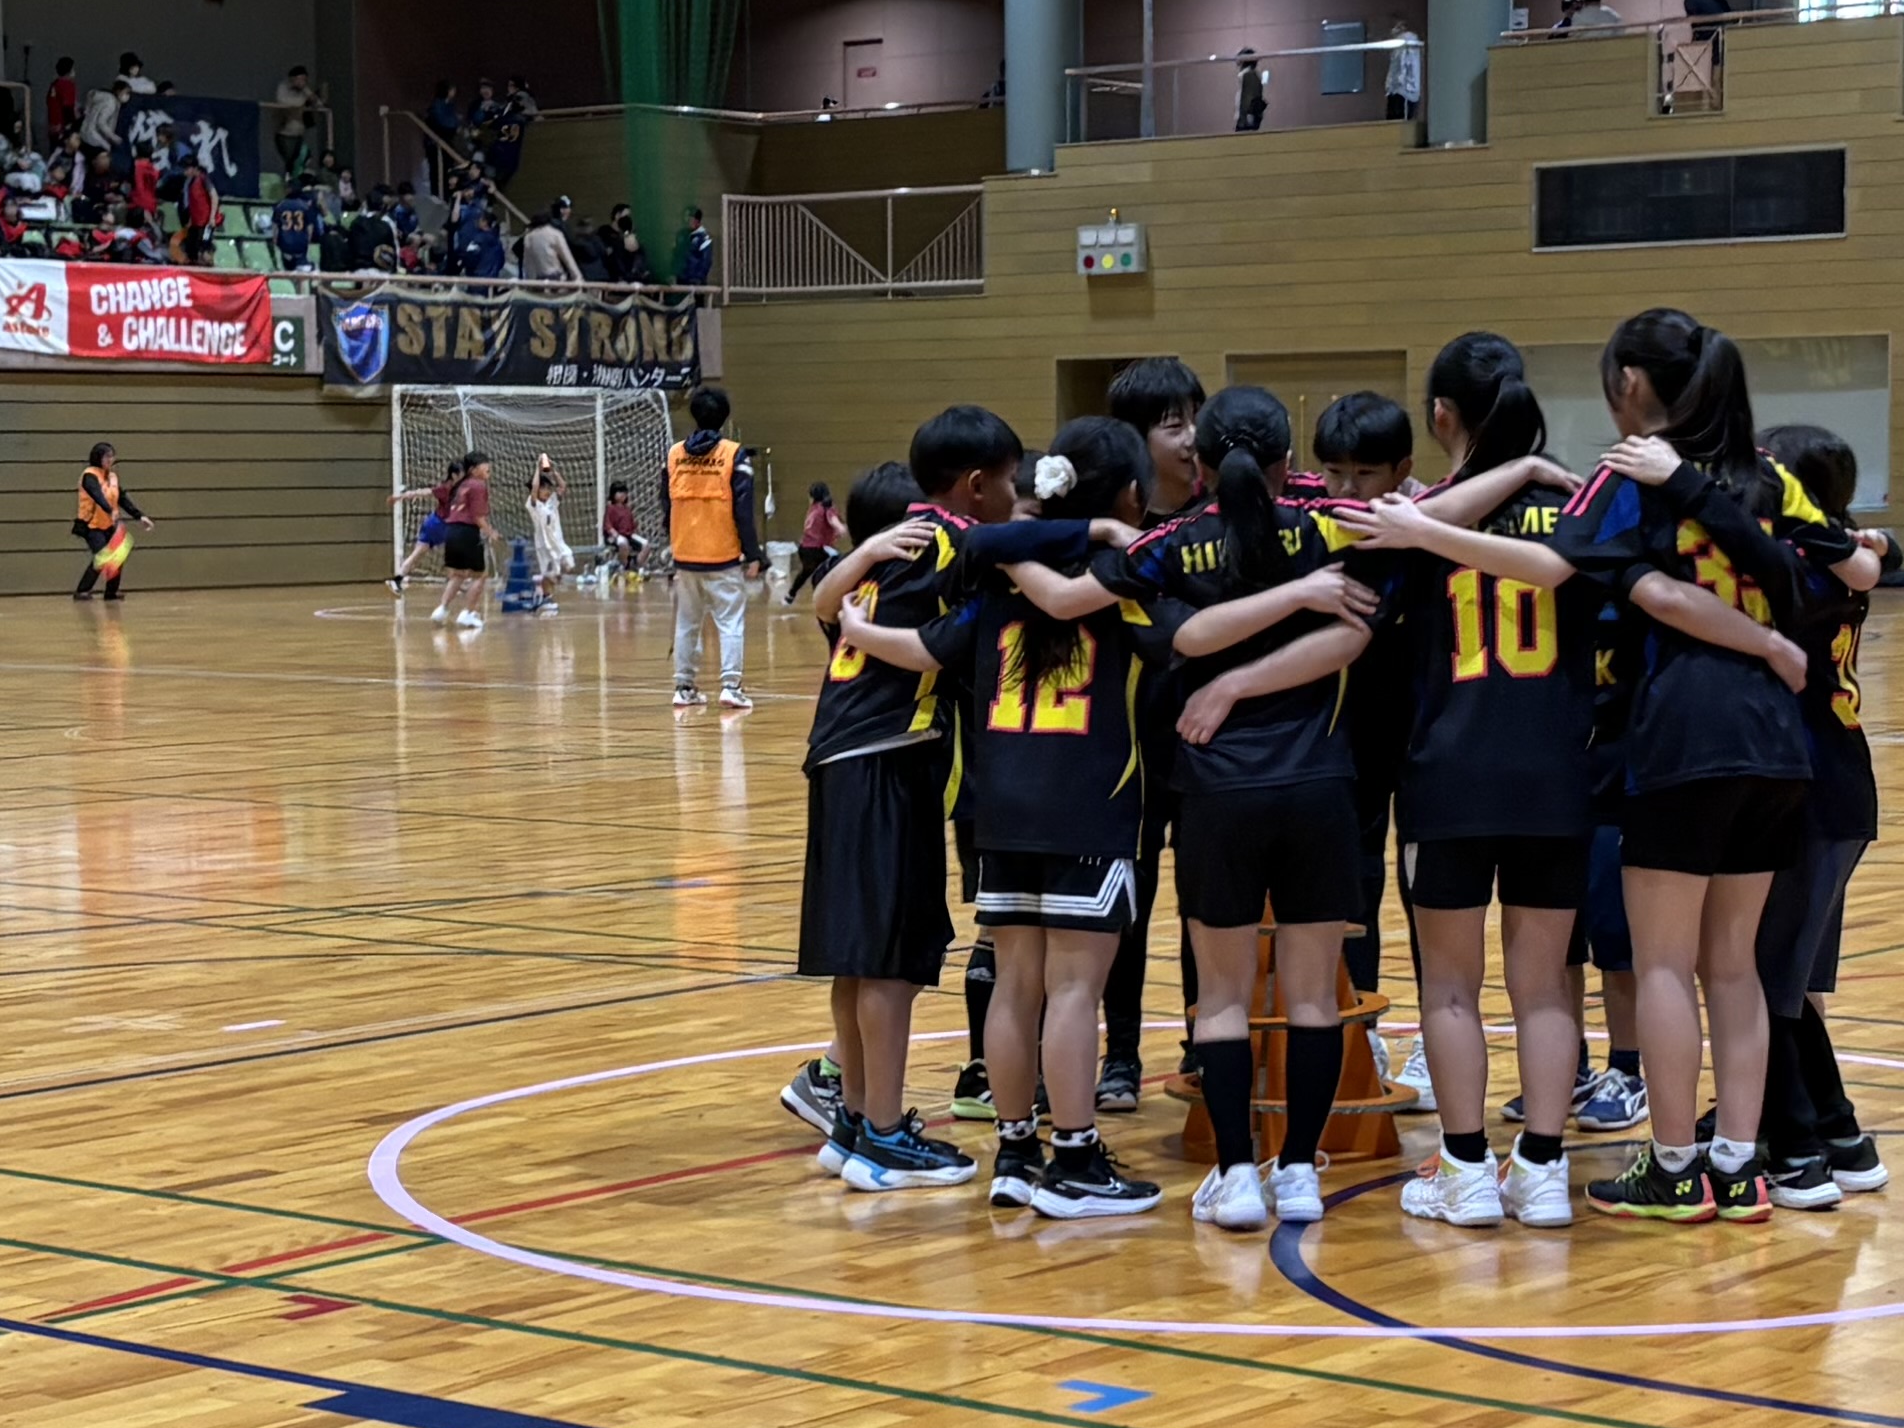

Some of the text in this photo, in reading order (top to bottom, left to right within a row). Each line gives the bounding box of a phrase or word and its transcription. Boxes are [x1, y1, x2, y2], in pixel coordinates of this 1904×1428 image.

[281, 210, 304, 231] 33
[90, 276, 194, 316] CHANGE
[97, 316, 247, 357] & CHALLENGE
[273, 321, 295, 353] C
[272, 355, 298, 367] コート
[1447, 566, 1558, 682] 10
[987, 621, 1096, 735] 12
